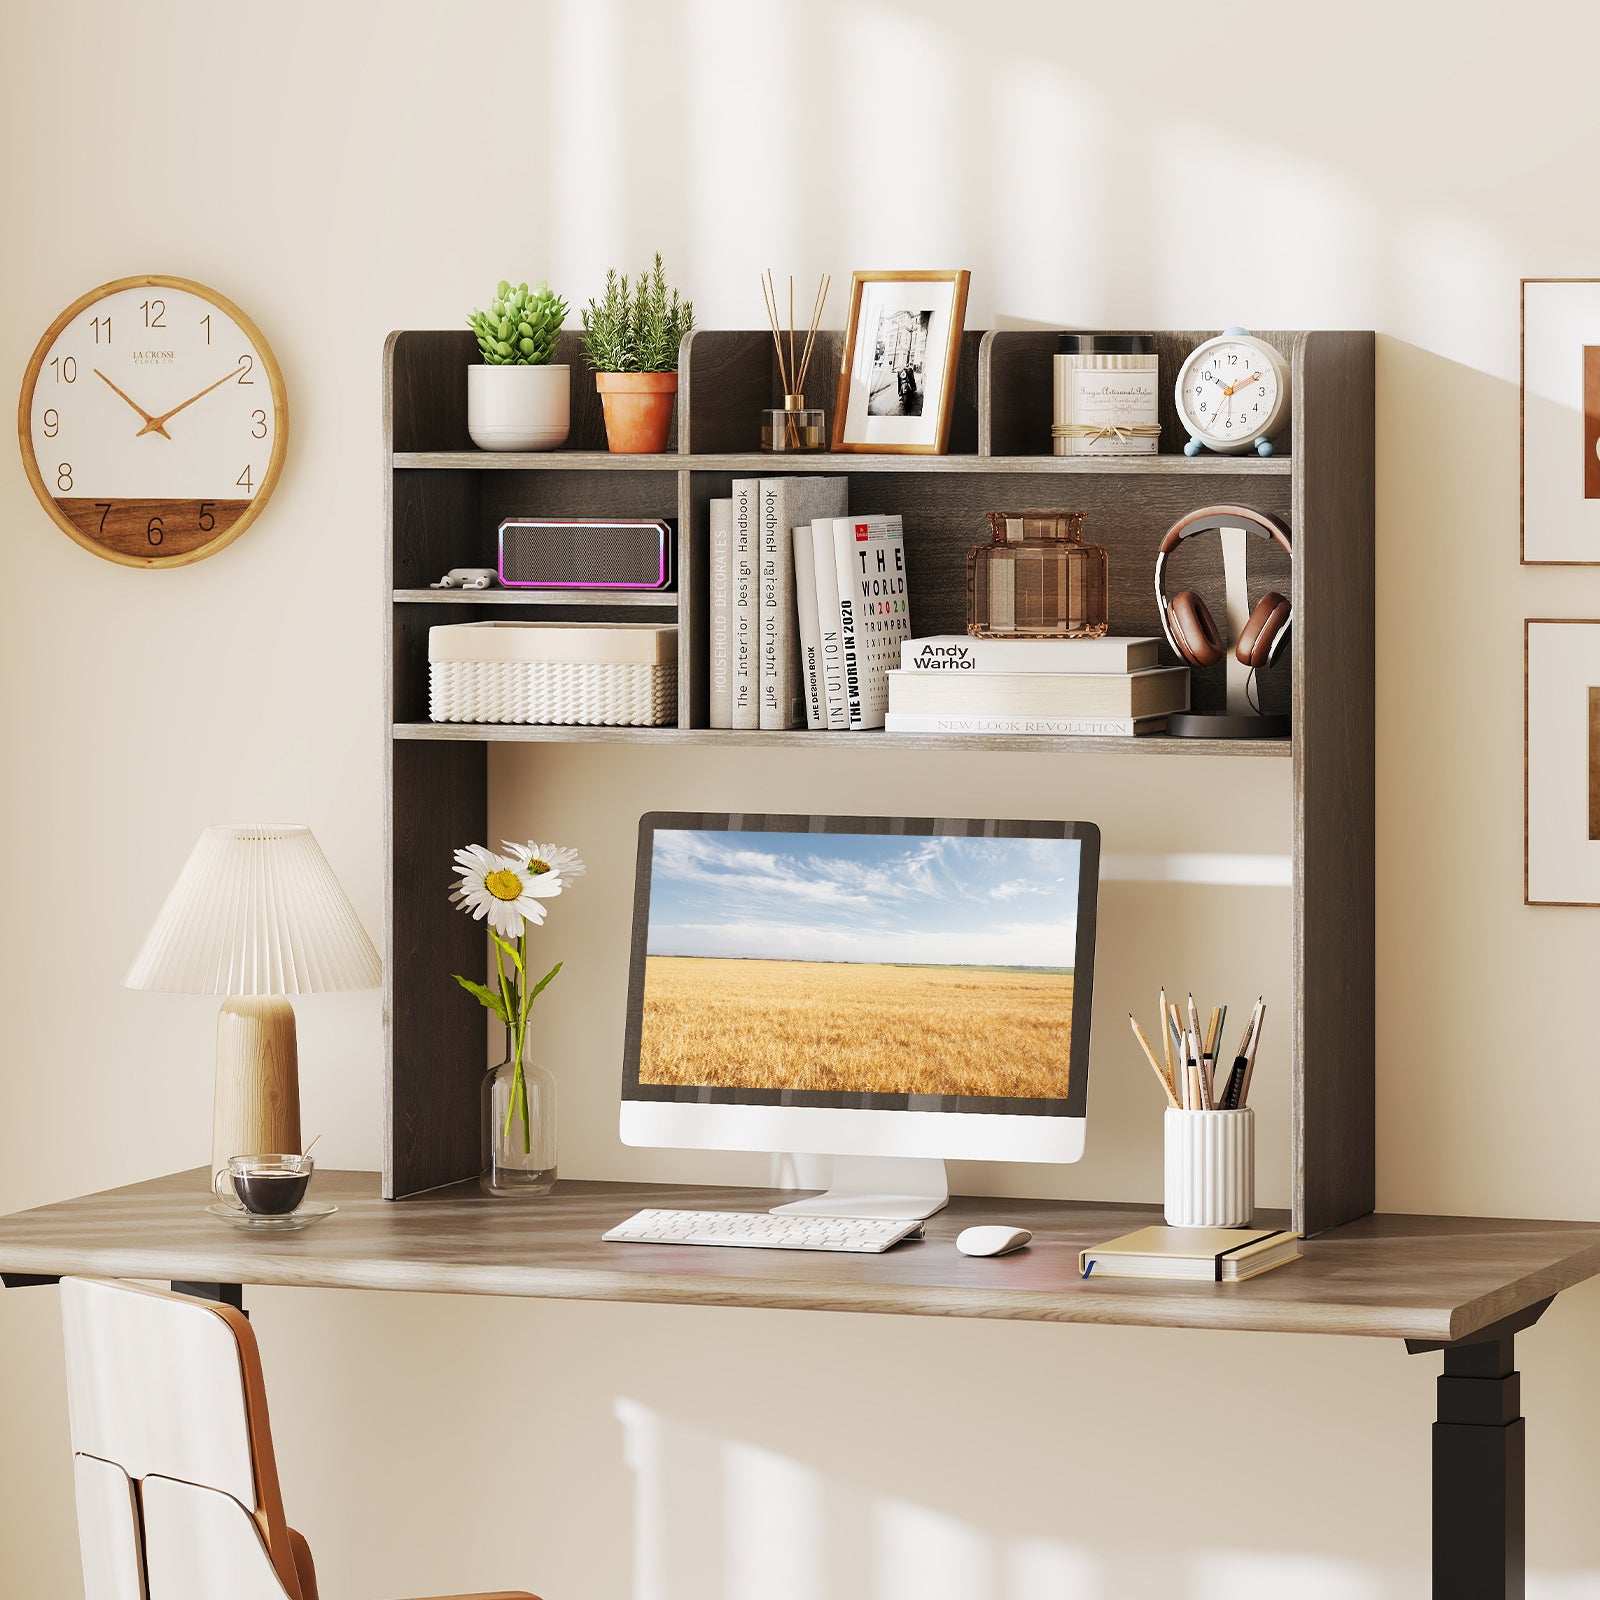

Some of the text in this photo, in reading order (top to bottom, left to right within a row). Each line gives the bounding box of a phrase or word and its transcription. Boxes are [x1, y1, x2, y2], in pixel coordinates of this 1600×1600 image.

[140, 300, 166, 328] 12
[90, 317, 111, 344] 11
[200, 314, 210, 345] 1
[146, 351, 176, 359] CROSSE
[1214, 360, 1221, 369] 11
[1228, 355, 1238, 365] 12
[50, 356, 77, 383] 10
[238, 354, 254, 384] 2
[1201, 371, 1212, 381] 10
[1196, 386, 1202, 396] 9
[1259, 387, 1265, 397] 3
[1200, 402, 1206, 412] 8
[1240, 414, 1247, 423] 5
[1253, 403, 1258, 412] 4
[44, 408, 58, 438] 9
[252, 410, 268, 438] 3
[1226, 418, 1232, 428] 6
[57, 462, 74, 492] 8
[236, 464, 254, 494] 4
[94, 504, 112, 532] 7
[147, 517, 164, 546] 6
[198, 504, 215, 532] 5
[859, 548, 902, 574] THE
[738, 490, 750, 708] The Interior Design Handbook
[862, 578, 904, 597] WORLD
[715, 530, 726, 693] HOUSEHOLD DECORATES
[841, 600, 862, 724] THE WORLD IN 2020
[914, 658, 975, 670] Warhol
[921, 644, 969, 659] Andy
[824, 632, 844, 723] INTUITION
[937, 720, 1126, 733] NEW LOOK REVOLUTION
